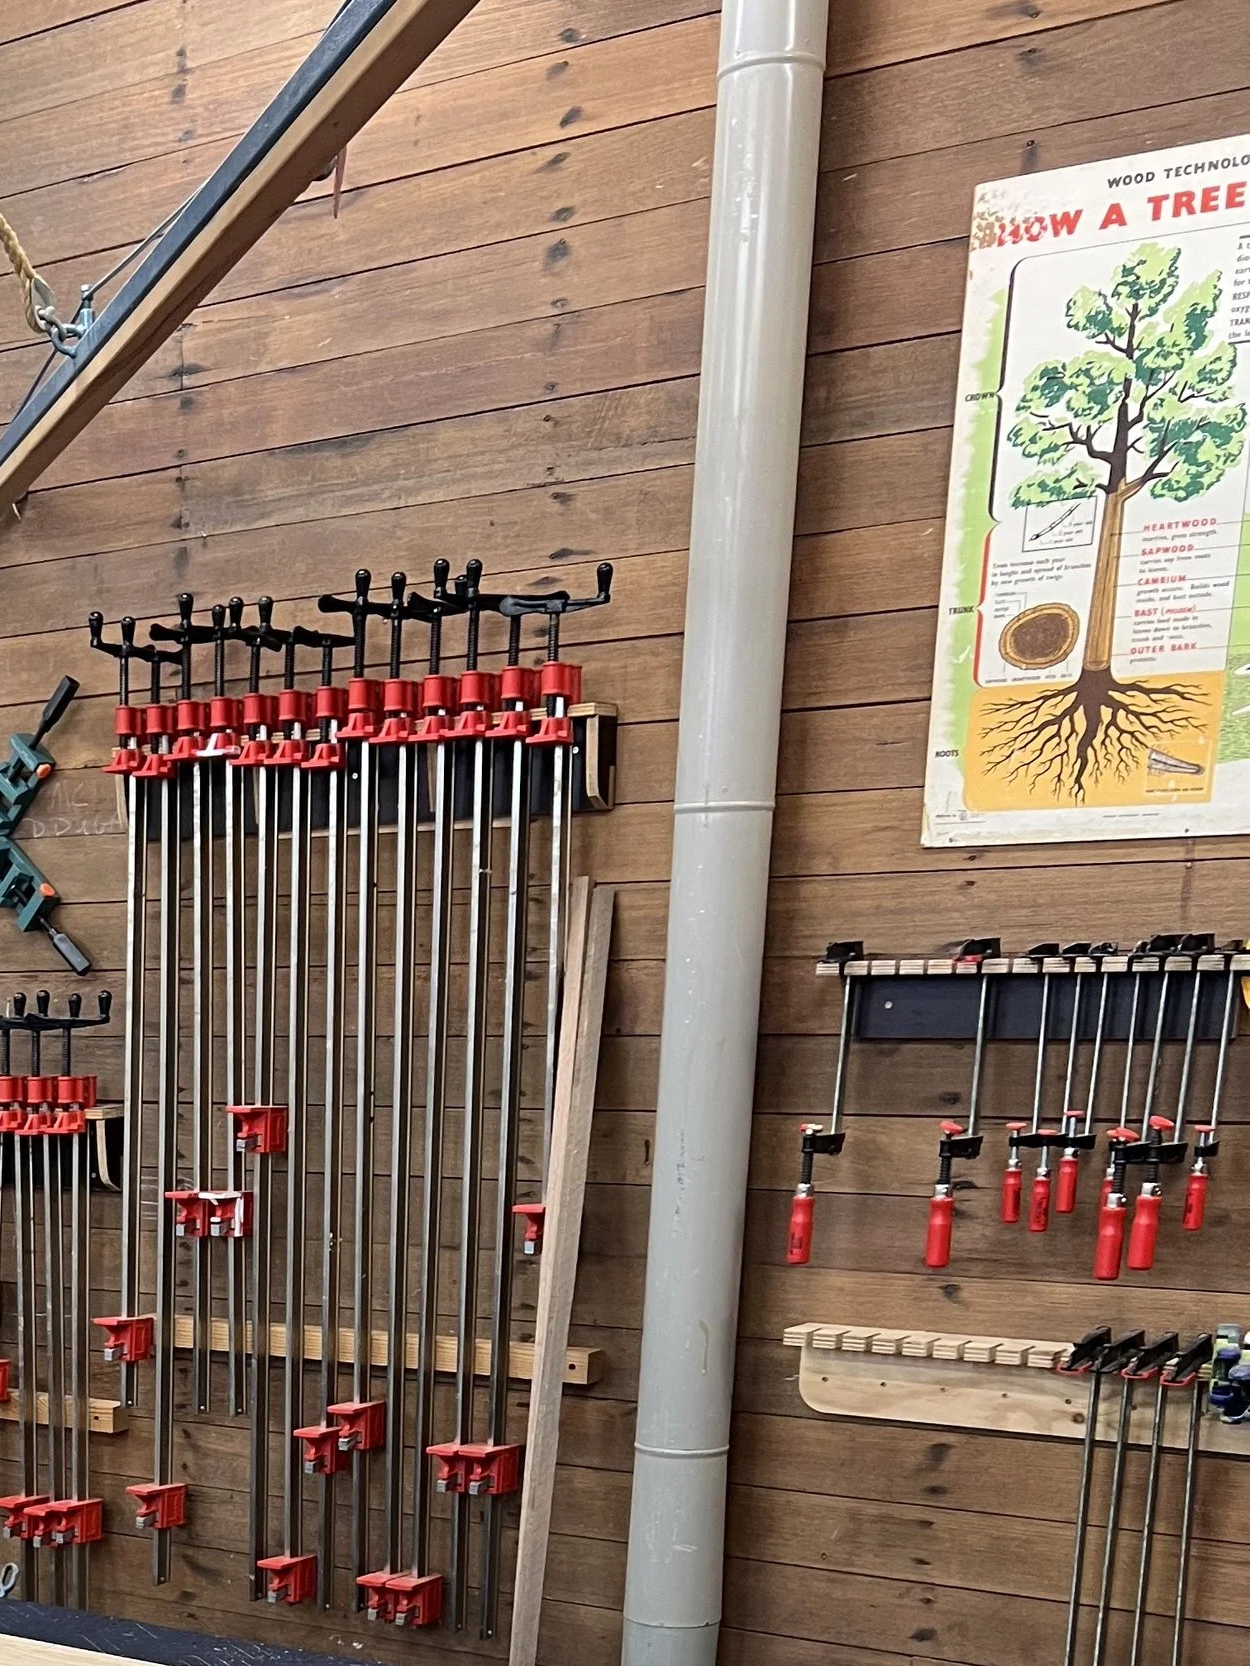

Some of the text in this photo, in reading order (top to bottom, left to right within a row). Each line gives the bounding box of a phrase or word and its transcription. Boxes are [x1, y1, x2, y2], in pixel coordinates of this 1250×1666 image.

[1107, 154, 1250, 189] WOOD TECHNOLO
[1098, 202, 1127, 230] A
[1147, 181, 1247, 221] TREE
[964, 391, 995, 402] CROWN
[1143, 518, 1217, 532] HEARTWOOD
[1141, 544, 1194, 556] SAPWOOD
[1137, 575, 1187, 586] CAMBIUM
[948, 605, 975, 615] TRUNK
[1134, 607, 1158, 617] BAST
[1130, 642, 1198, 655] OUTER BARK
[935, 749, 959, 758] ROOTS
